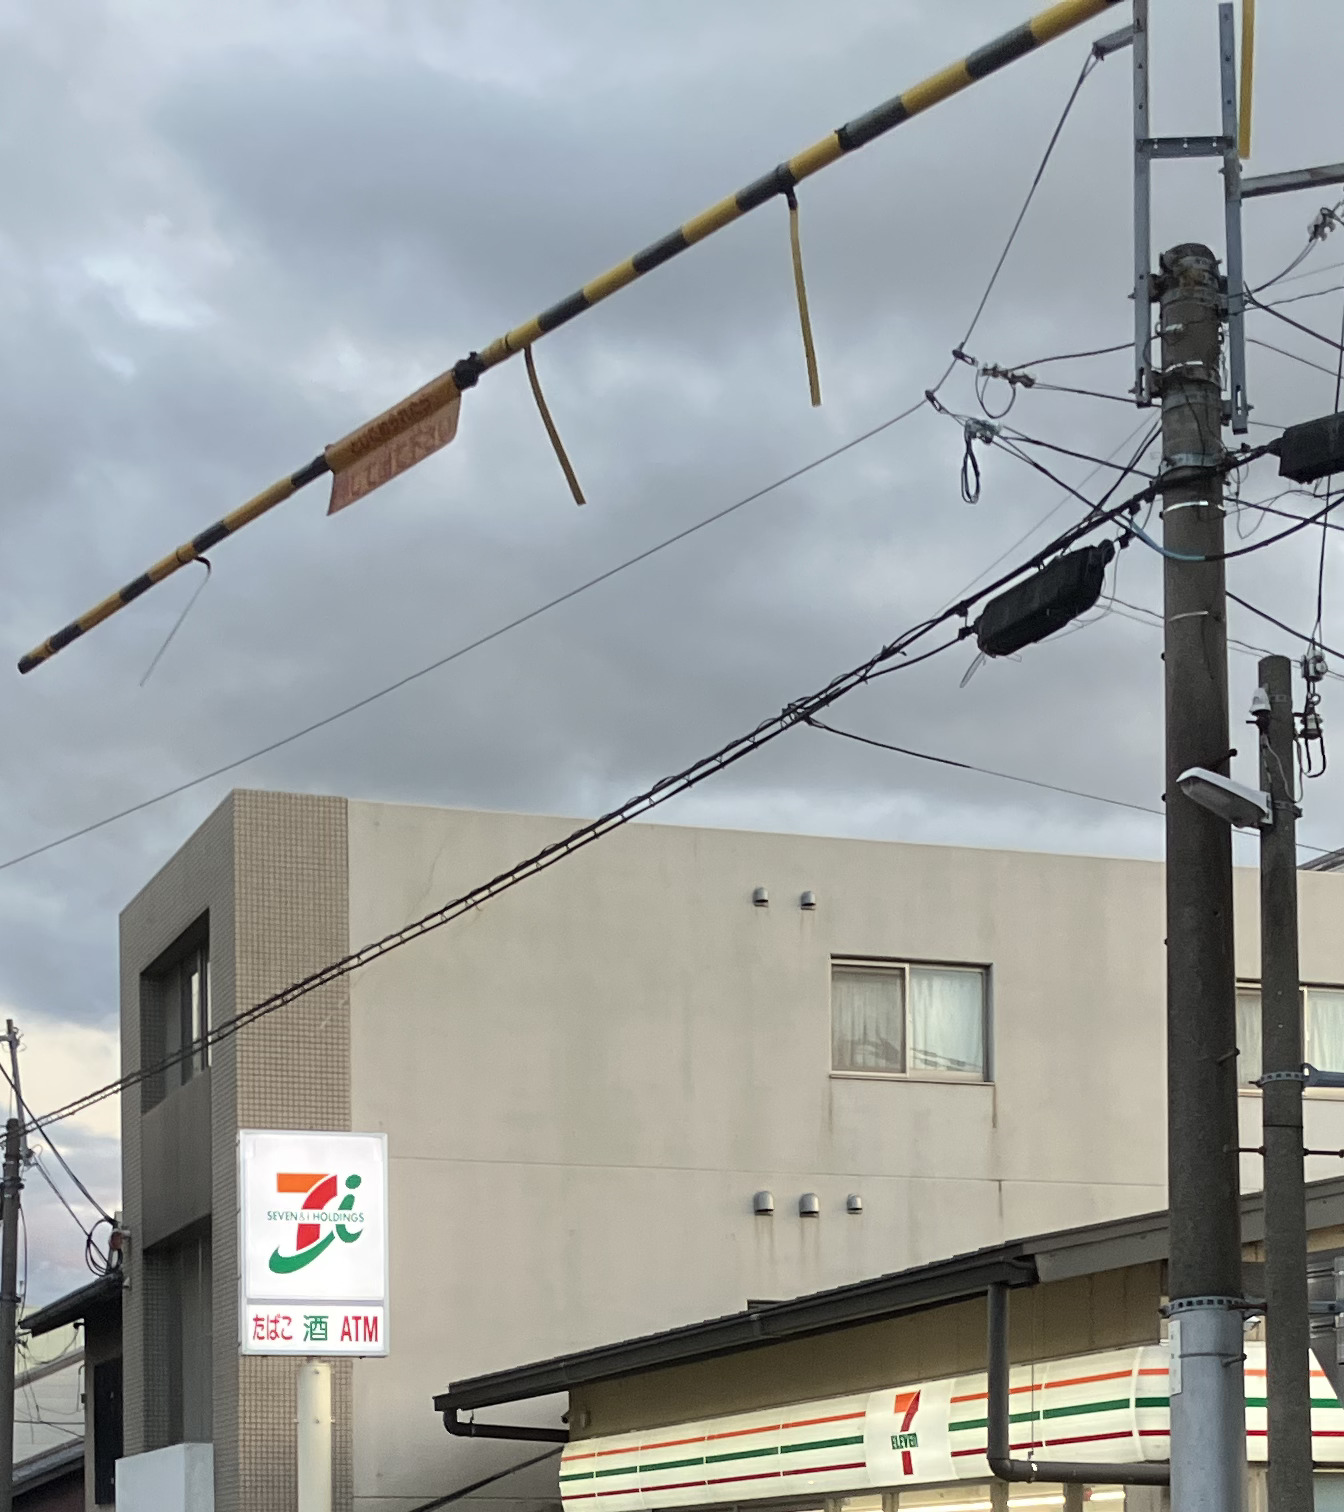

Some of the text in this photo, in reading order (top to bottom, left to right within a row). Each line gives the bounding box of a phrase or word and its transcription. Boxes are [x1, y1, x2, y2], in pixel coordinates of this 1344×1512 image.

[313, 1212, 365, 1223] HOLDINGS
[252, 1313, 379, 1342] たばこ 酒 ATM
